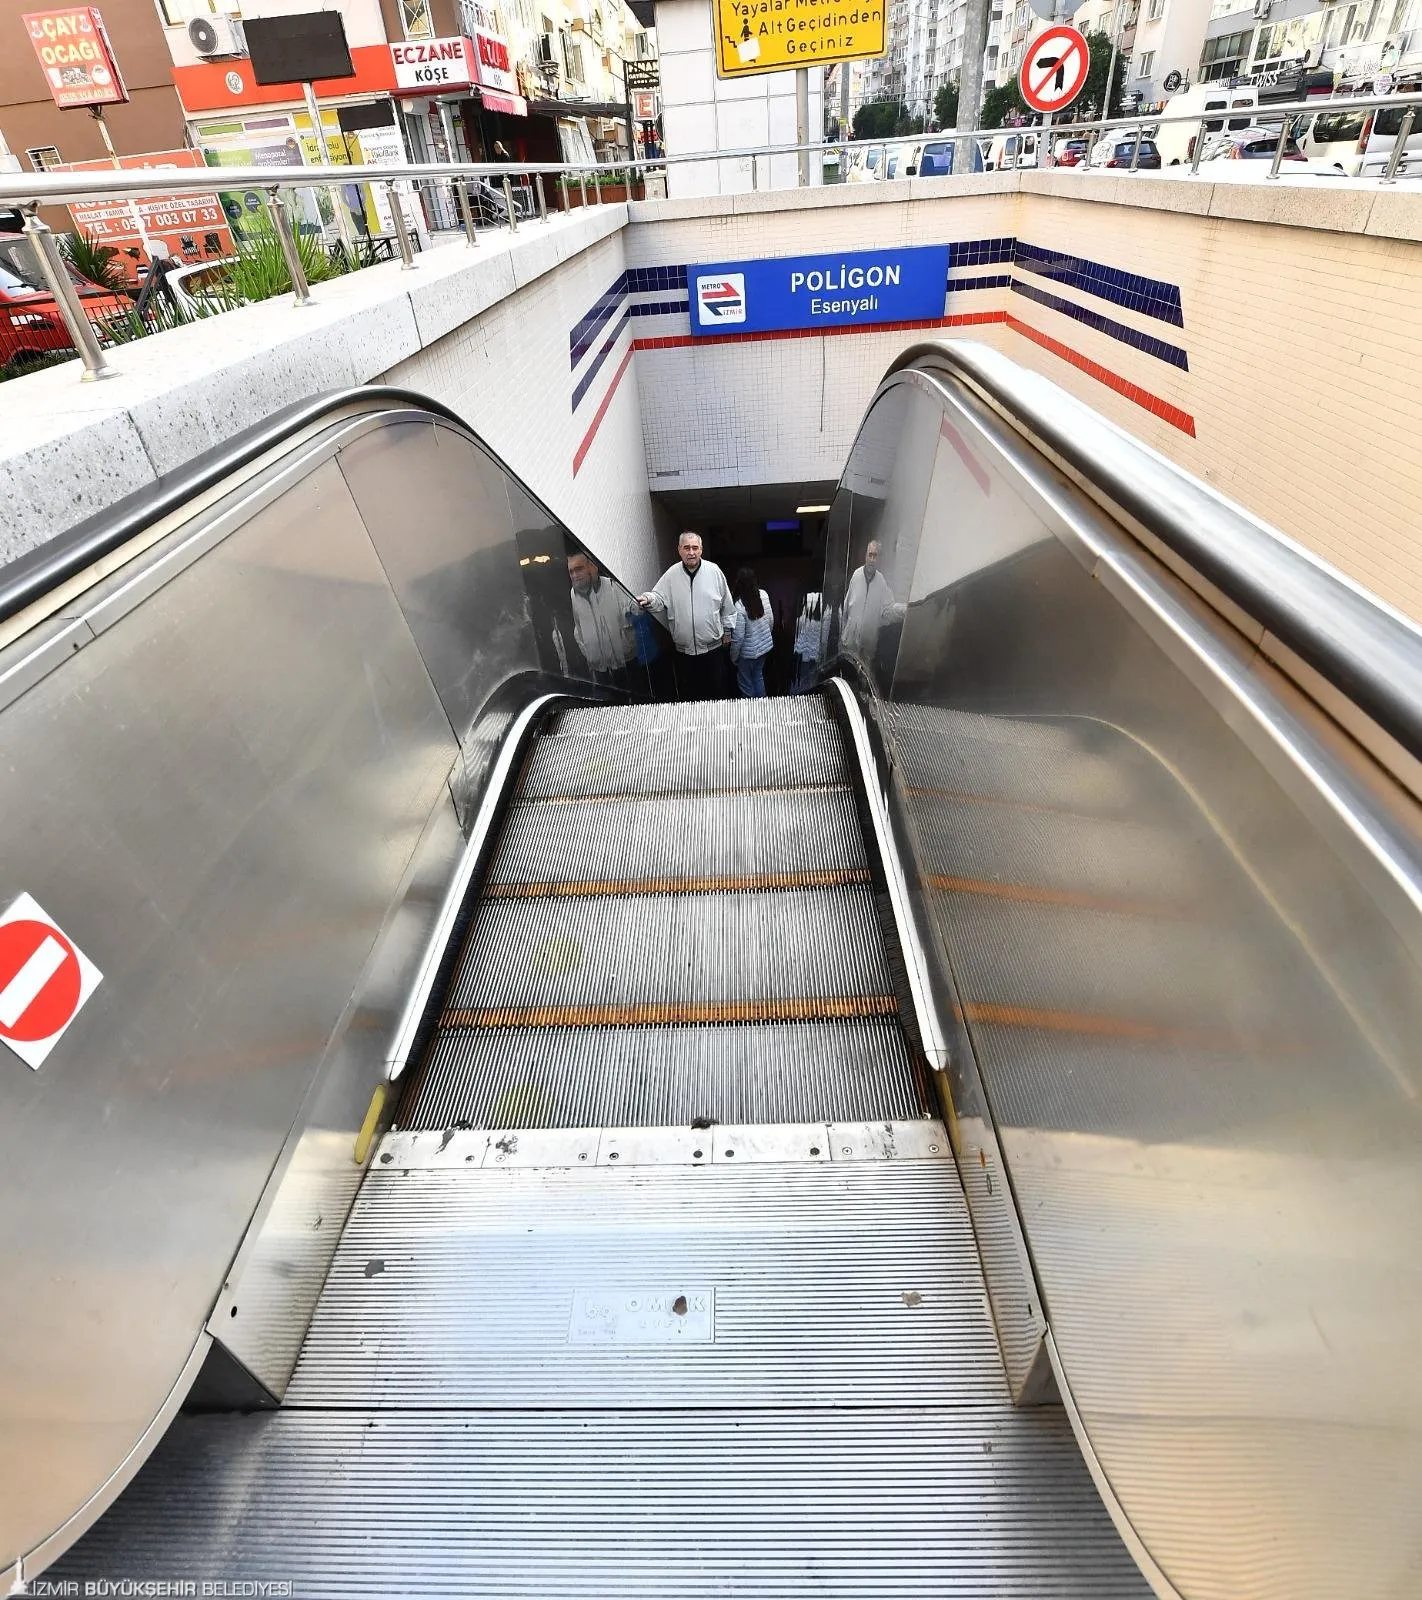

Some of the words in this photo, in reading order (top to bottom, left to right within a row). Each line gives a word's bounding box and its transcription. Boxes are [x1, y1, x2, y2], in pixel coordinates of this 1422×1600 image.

[731, 0, 789, 18] Yayalar
[42, 15, 78, 42] ÇAY
[41, 38, 102, 65] OCAĞI
[392, 42, 464, 65] ECZANE
[786, 36, 854, 54] Geçiniz
[415, 65, 449, 84] KÖŞE
[85, 222, 113, 235] TEL
[156, 210, 180, 226] 003
[182, 210, 198, 224] 07
[201, 207, 218, 221] 33
[701, 282, 721, 290] METRO
[791, 263, 901, 293] POLİGON
[811, 294, 878, 316] Esenyalı
